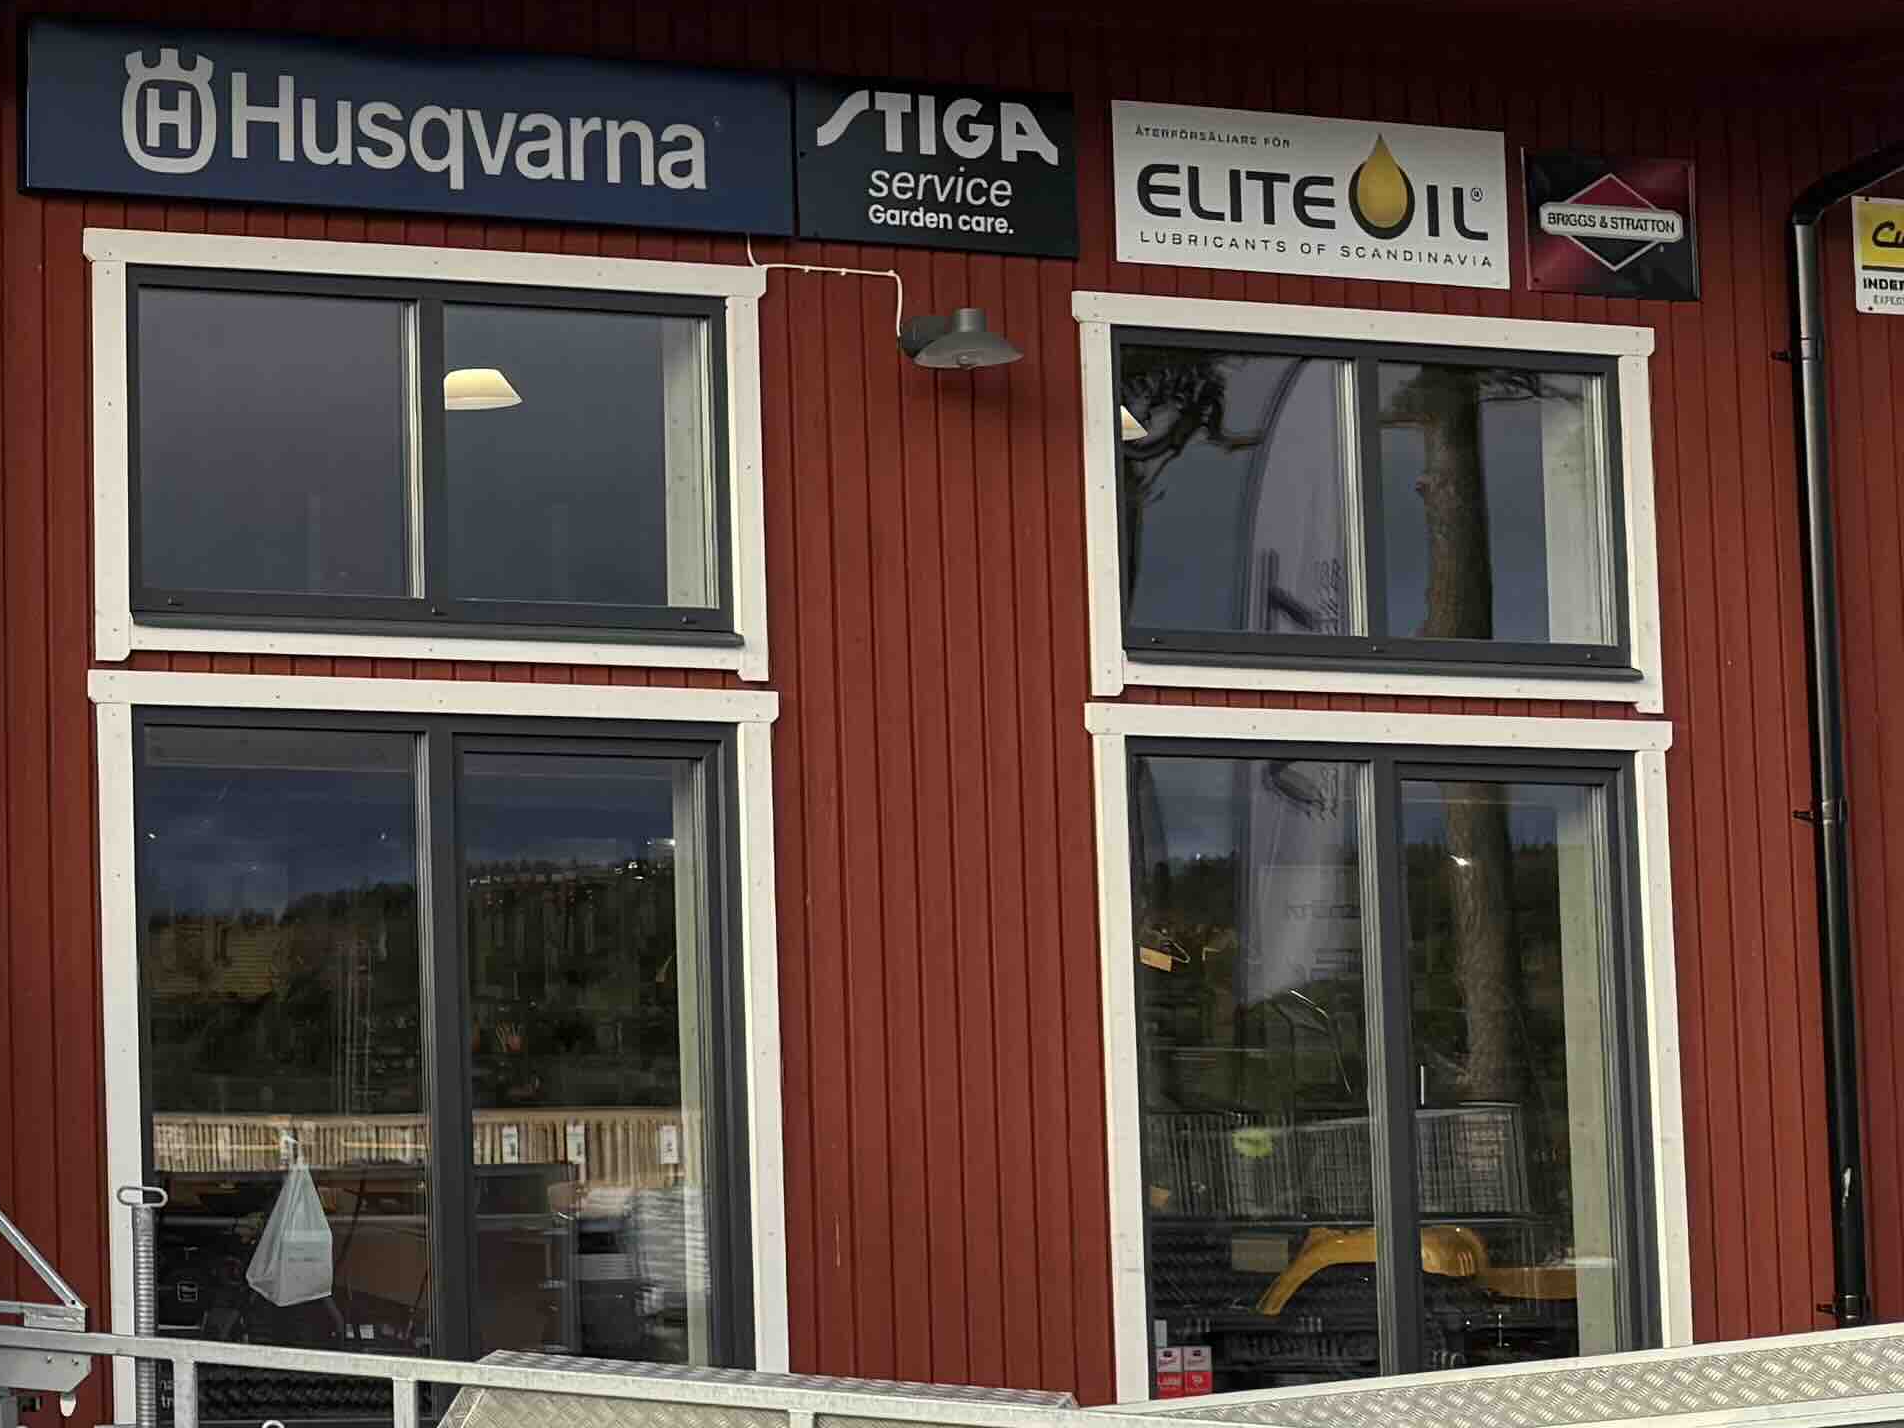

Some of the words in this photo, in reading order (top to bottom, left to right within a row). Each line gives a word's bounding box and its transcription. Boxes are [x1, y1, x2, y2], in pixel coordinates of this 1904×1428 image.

[232, 72, 708, 191] Husqvarna
[817, 90, 1059, 166] STIGA
[868, 166, 1013, 207] service
[868, 204, 953, 230] Garden
[958, 213, 1014, 234] care.
[1547, 212, 1596, 228] BRIGGS
[1599, 215, 1608, 229] &
[1610, 216, 1675, 233] STRATTON
[1140, 231, 1286, 253] LUBRICANTS
[1300, 242, 1327, 256] OF
[1340, 245, 1492, 268] SCANDINAVIA
